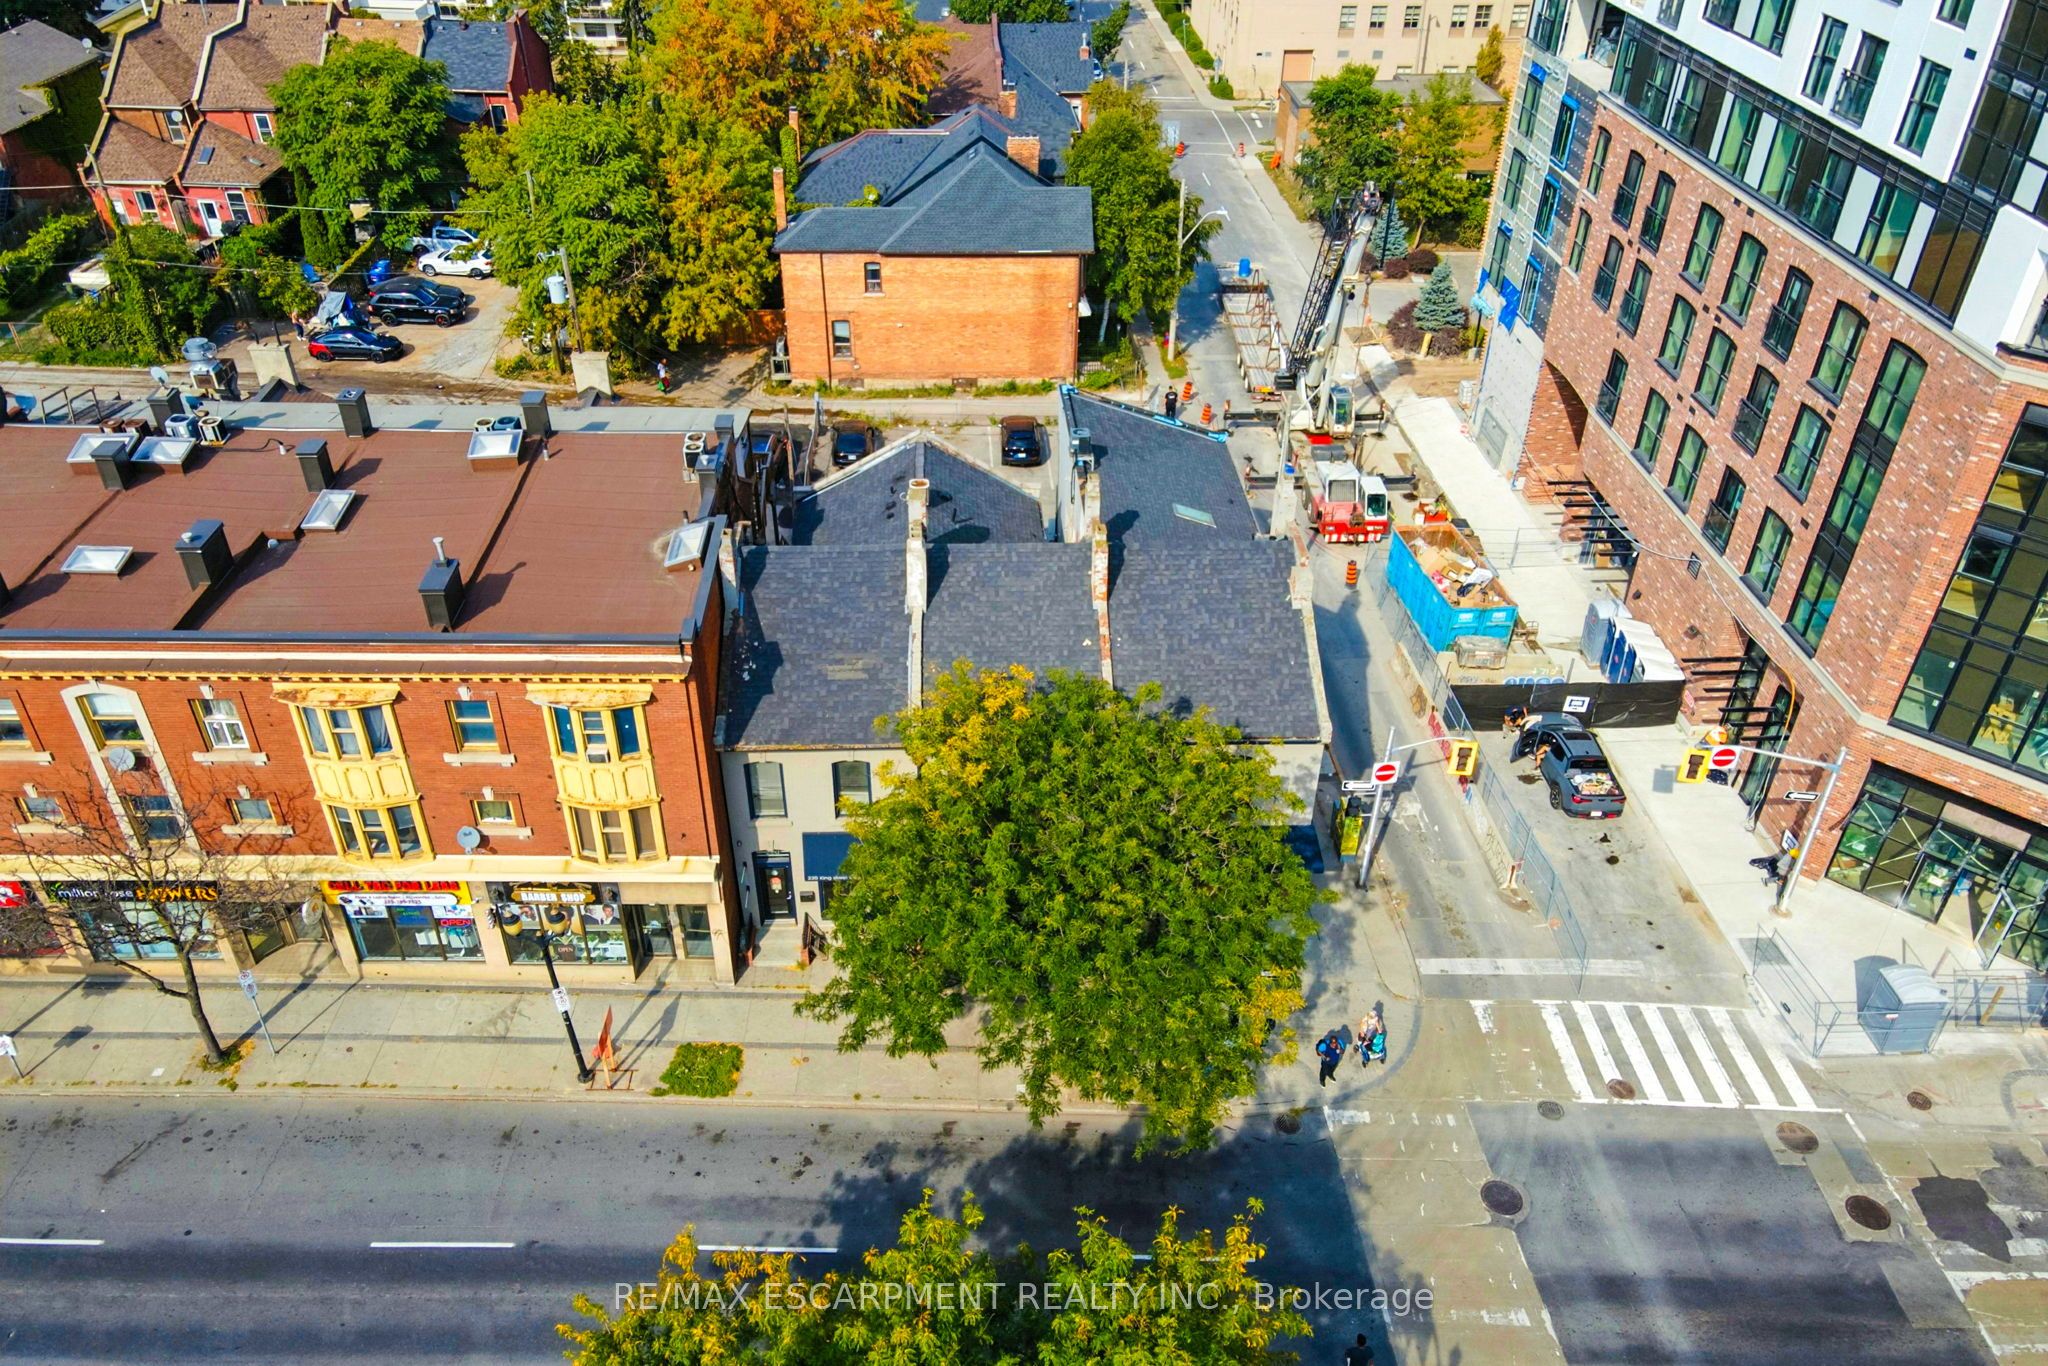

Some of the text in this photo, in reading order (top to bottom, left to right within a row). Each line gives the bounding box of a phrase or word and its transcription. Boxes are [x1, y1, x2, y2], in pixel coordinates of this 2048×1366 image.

[520, 890, 587, 902] BARBER SHOP
[440, 919, 471, 927] OPEN
